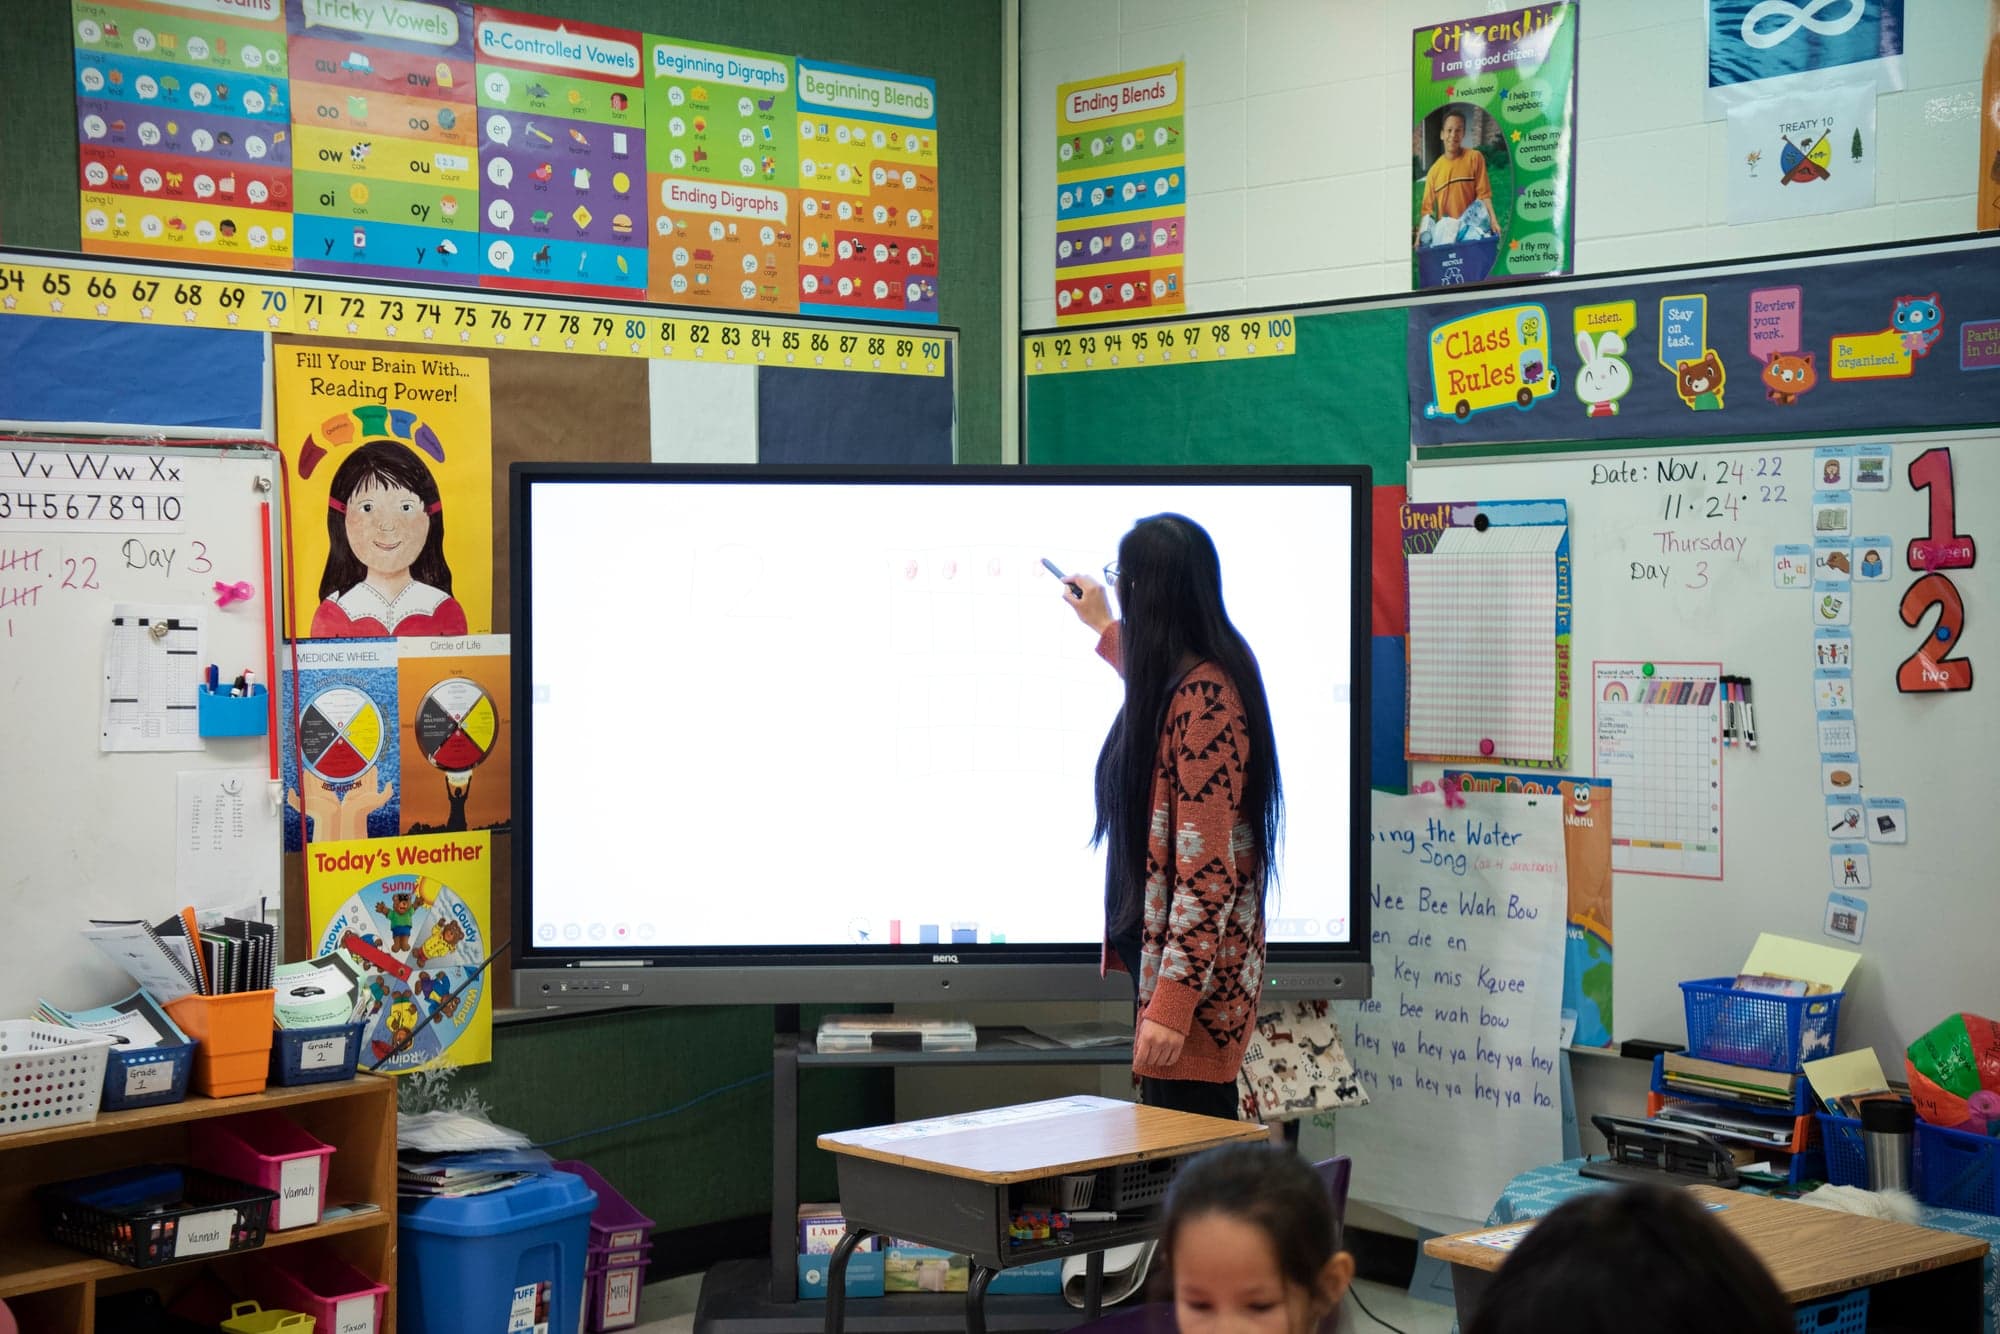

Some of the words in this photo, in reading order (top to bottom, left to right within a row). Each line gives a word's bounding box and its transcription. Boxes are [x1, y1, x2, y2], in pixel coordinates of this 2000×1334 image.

[316, 0, 375, 28] Tricky
[382, 5, 448, 36] Vowels
[484, 30, 582, 59] R-Controlled
[586, 46, 634, 69] Vowels
[657, 49, 724, 79] Beginning
[728, 60, 785, 85] Digraphs
[1447, 60, 1463, 71] am
[1475, 53, 1500, 70] good
[407, 73, 430, 87] aw
[806, 75, 880, 108] Beginning
[884, 86, 929, 109] Blends
[1074, 93, 1118, 114] Ending
[1122, 81, 1165, 105] Blends
[1513, 91, 1529, 101] help
[316, 105, 339, 119] oo
[409, 118, 430, 131] oo
[493, 125, 505, 135] er
[1779, 119, 1819, 134] TREATY
[1821, 117, 1834, 127] 10
[1528, 132, 1547, 142] keep
[319, 149, 343, 163] ow
[410, 160, 430, 174] ou
[320, 191, 335, 207] oi
[671, 185, 717, 209] Ending
[721, 191, 778, 214] Digraphs
[411, 203, 430, 222] oy
[496, 209, 508, 220] ur
[324, 238, 335, 256] y
[416, 247, 426, 264] y
[494, 250, 507, 261] or
[1754, 300, 1796, 313] Review
[42, 273, 71, 296] 65
[88, 276, 116, 299] 66
[132, 280, 160, 303] 67
[174, 284, 202, 305] 68
[219, 287, 245, 308] 69
[261, 290, 287, 312] 70
[304, 294, 322, 315] 71
[340, 297, 365, 318] 72
[380, 301, 404, 321] 73
[416, 303, 441, 324] 74
[454, 307, 476, 327] 75
[491, 309, 511, 330] 76
[523, 312, 547, 332] 77
[560, 315, 580, 335] 78
[593, 317, 613, 337] 79
[625, 319, 646, 339] 80
[661, 322, 675, 341] 81
[690, 324, 710, 343] 82
[721, 327, 740, 346] 83
[751, 328, 770, 348] 84
[782, 331, 800, 350] 85
[810, 333, 829, 352] 86
[839, 336, 857, 353] 87
[868, 338, 885, 356] 88
[896, 340, 913, 358] 89
[922, 341, 940, 360] 90
[1587, 310, 1623, 326] Listen.
[1668, 308, 1694, 322] Stay
[1753, 316, 1781, 329] your
[1668, 325, 1681, 334] on
[1753, 328, 1784, 340] work.
[1032, 341, 1045, 358] 91
[1055, 339, 1071, 356] 92
[1079, 337, 1096, 354] 93
[1104, 334, 1121, 352] 94
[1132, 332, 1148, 350] 95
[1157, 330, 1174, 348] 96
[1183, 327, 1200, 345] 97
[1212, 325, 1230, 343] 98
[1241, 322, 1261, 340] 99
[1268, 318, 1292, 338] 100
[1446, 327, 1511, 359] Class
[1668, 335, 1694, 347] task.
[1838, 345, 1853, 356] Be
[296, 352, 322, 369] Fill
[327, 354, 366, 370] Your
[372, 357, 416, 374] Brain
[422, 360, 470, 377] With...
[1838, 353, 1899, 369] organized.
[1448, 363, 1516, 396] Rules
[310, 377, 387, 405] Reading
[394, 382, 457, 402] Power!
[1591, 460, 1648, 485] Date:
[1399, 504, 1450, 531] Great!
[1653, 530, 1747, 562] Thursday
[122, 538, 175, 578] Day
[187, 541, 212, 574] 3
[1630, 562, 1671, 588] Day
[1686, 561, 1708, 589] 3
[1557, 554, 1571, 626] Terrific
[430, 641, 454, 651] Circle
[455, 641, 464, 650] of
[466, 641, 481, 650] Life
[296, 651, 344, 664] MEDICINE
[347, 651, 379, 662] WHEEL
[1922, 668, 1949, 681] two
[1565, 815, 1593, 828] Menu
[1426, 817, 1456, 843] the
[1467, 820, 1523, 847] Water
[315, 849, 391, 874] Today's
[396, 842, 483, 865] Weather
[1420, 842, 1467, 876] Song
[381, 880, 418, 894] Sunny
[1419, 886, 1448, 914] Bee
[1459, 891, 1496, 917] Wah
[1507, 894, 1538, 920] Bow
[452, 903, 477, 944] Cloudy
[1408, 929, 1432, 947] die
[1448, 937, 1467, 952] en
[1394, 955, 1420, 989] Key
[1434, 970, 1462, 986] mis
[1400, 992, 1423, 1017] bee
[1435, 1006, 1469, 1024] wah
[1480, 1005, 1510, 1028] bow
[308, 1040, 333, 1051] Grade
[1355, 1023, 1379, 1055] hey
[1391, 1039, 1406, 1057] ya
[1418, 1030, 1442, 1060] hey
[1449, 1048, 1466, 1064] ya
[1476, 1037, 1501, 1069] hey
[1506, 1054, 1523, 1071] ya
[1531, 1047, 1553, 1075] hey
[316, 1051, 326, 1063] 2
[130, 1068, 157, 1079] Grade
[136, 1079, 147, 1089] 1
[283, 1186, 314, 1200] Vannah
[188, 1230, 220, 1243] Vannah
[820, 1226, 838, 1235] Am
[611, 1286, 628, 1299] MATH
